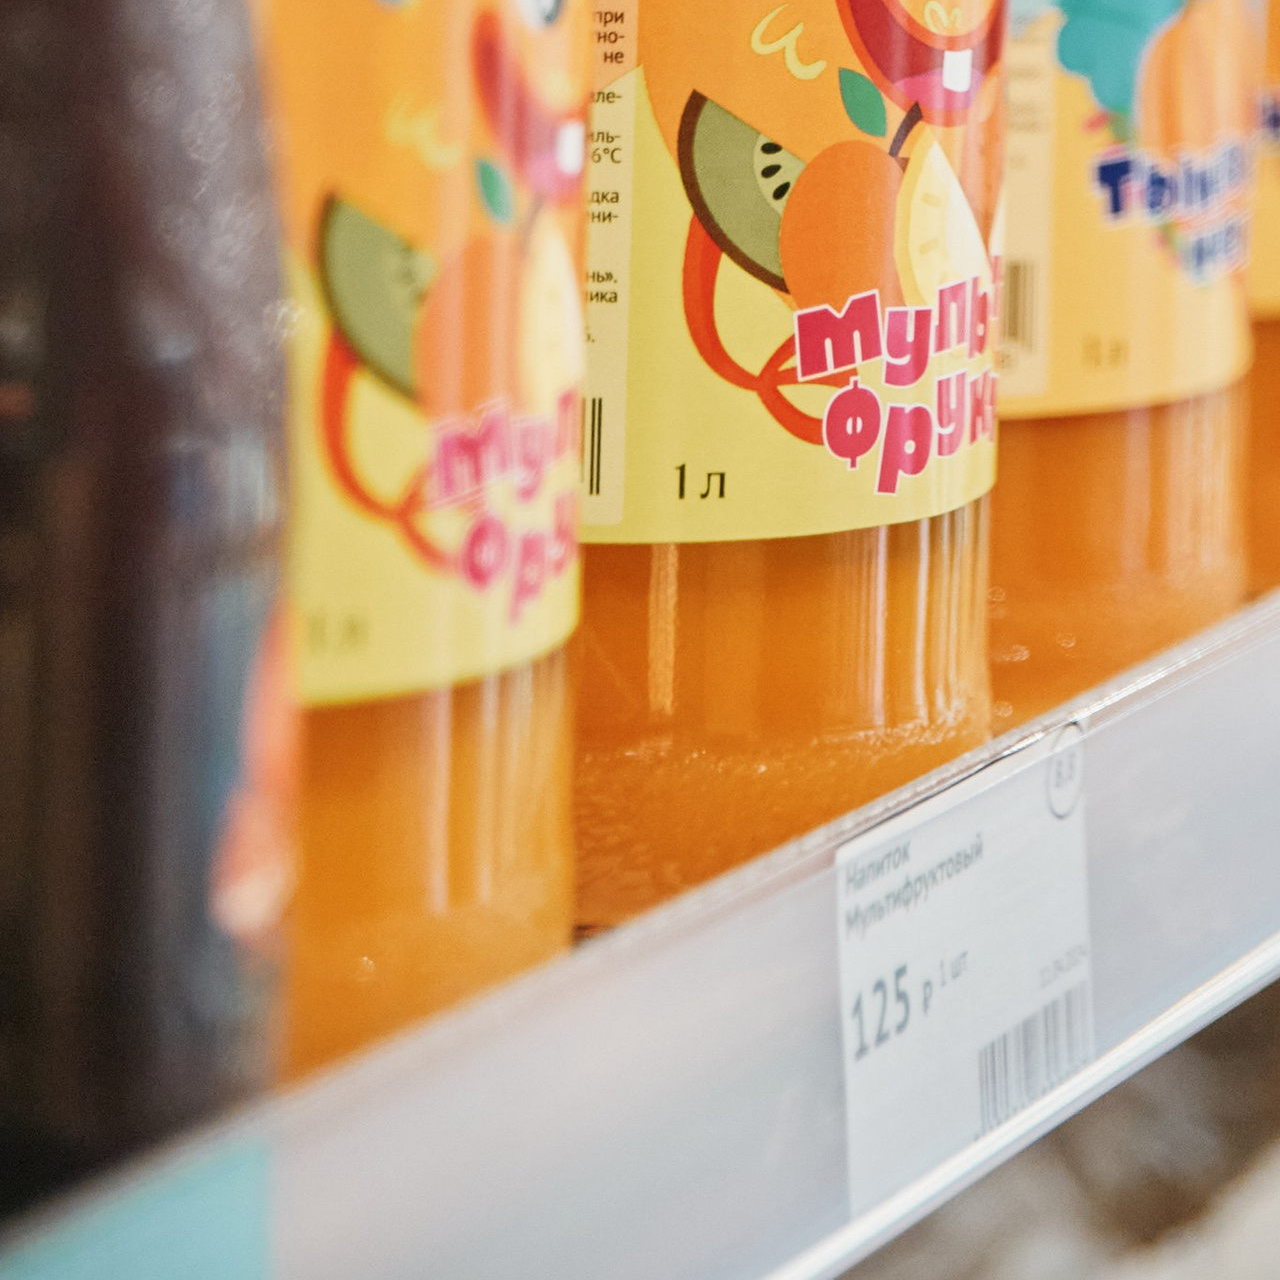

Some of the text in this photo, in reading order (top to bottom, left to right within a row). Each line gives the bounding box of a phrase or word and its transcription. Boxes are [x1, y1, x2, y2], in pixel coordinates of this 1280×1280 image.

[603, 51, 624, 64] не
[675, 463, 725, 500] 1 л
[846, 841, 912, 893] Напиток
[846, 832, 984, 939] Мультифруктовый
[851, 963, 911, 1062] 125
[950, 950, 968, 980] шт
